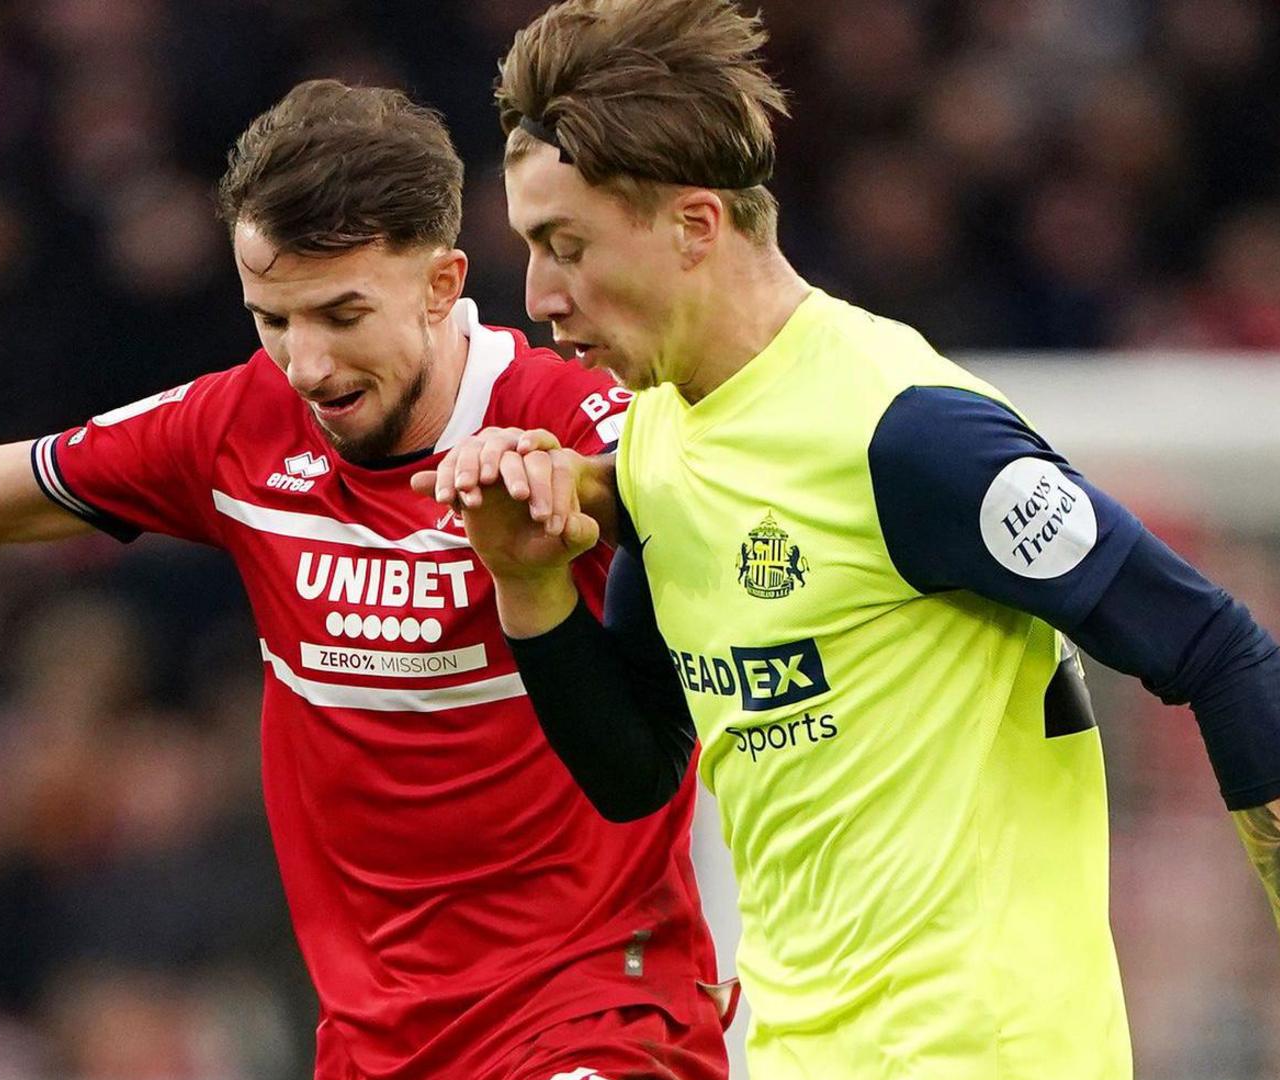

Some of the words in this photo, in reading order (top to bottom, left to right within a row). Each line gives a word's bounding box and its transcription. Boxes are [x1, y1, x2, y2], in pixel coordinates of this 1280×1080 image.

[1001, 475, 1051, 540] Hays
[1012, 485, 1077, 568] Travel
[295, 551, 474, 609] UNIBET
[320, 650, 375, 671] ZERO%
[380, 654, 458, 674] MISSION
